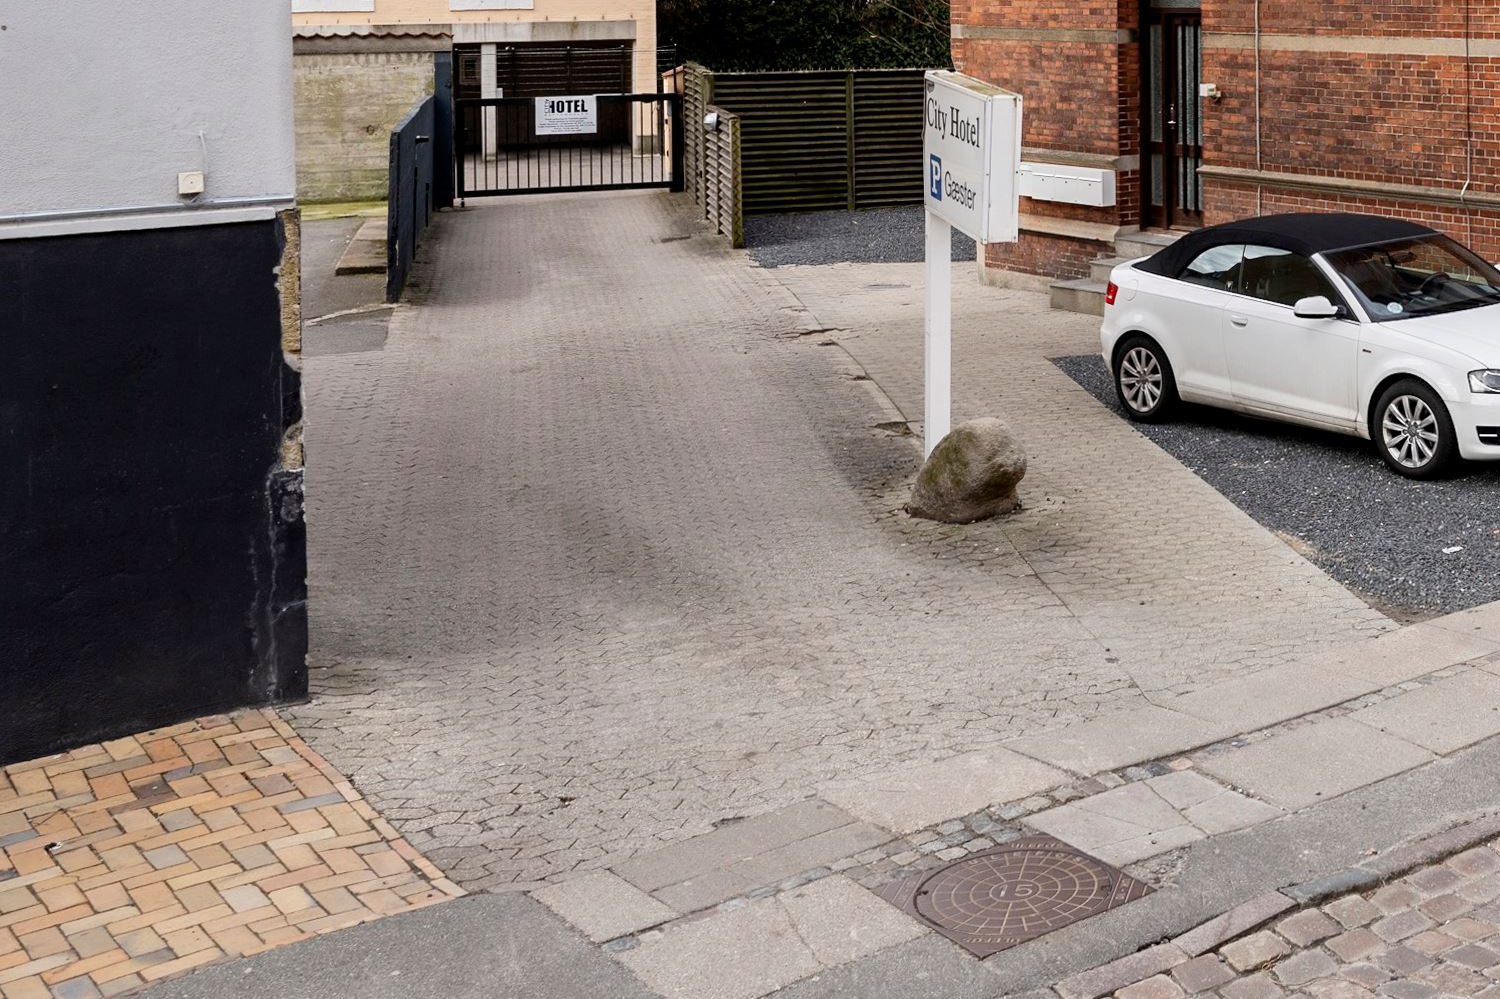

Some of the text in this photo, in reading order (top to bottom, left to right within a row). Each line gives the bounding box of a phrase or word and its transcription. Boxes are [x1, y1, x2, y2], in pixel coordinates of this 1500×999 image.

[927, 97, 980, 148] City Hotel
[930, 160, 976, 211] P Gæster
[999, 884, 1033, 897] 15
